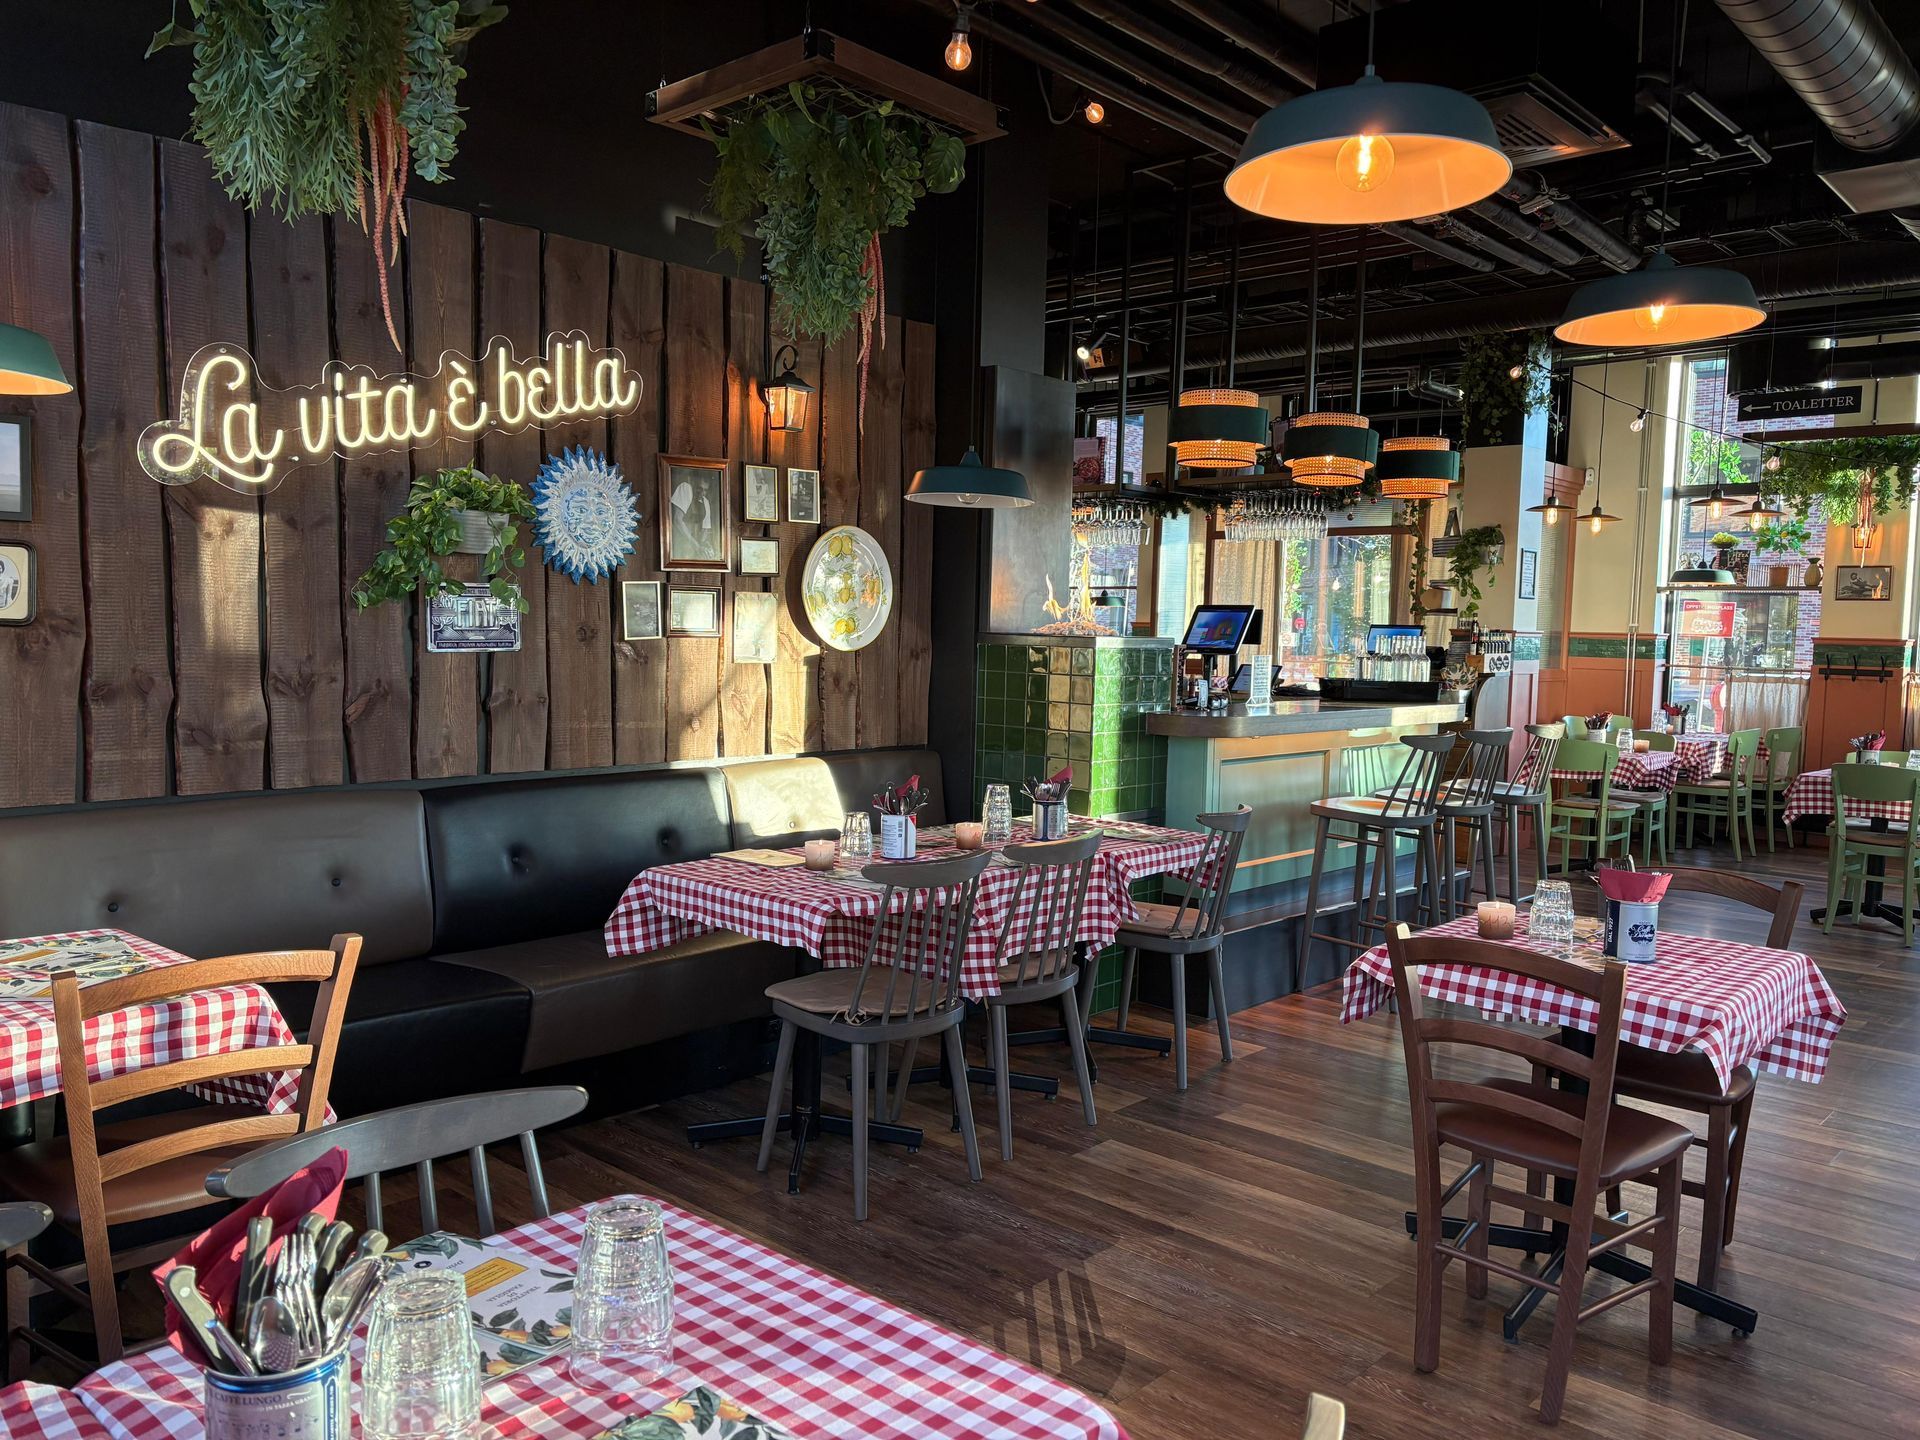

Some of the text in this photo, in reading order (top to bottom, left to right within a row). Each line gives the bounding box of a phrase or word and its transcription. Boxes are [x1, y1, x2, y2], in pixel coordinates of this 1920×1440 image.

[153, 340, 637, 482] La vita è bella
[1773, 396, 1854, 411] TOALETTER
[457, 600, 496, 627] FIAT
[497, 1286, 541, 1308] TRATTORIA
[241, 1394, 282, 1406] LUNGO
